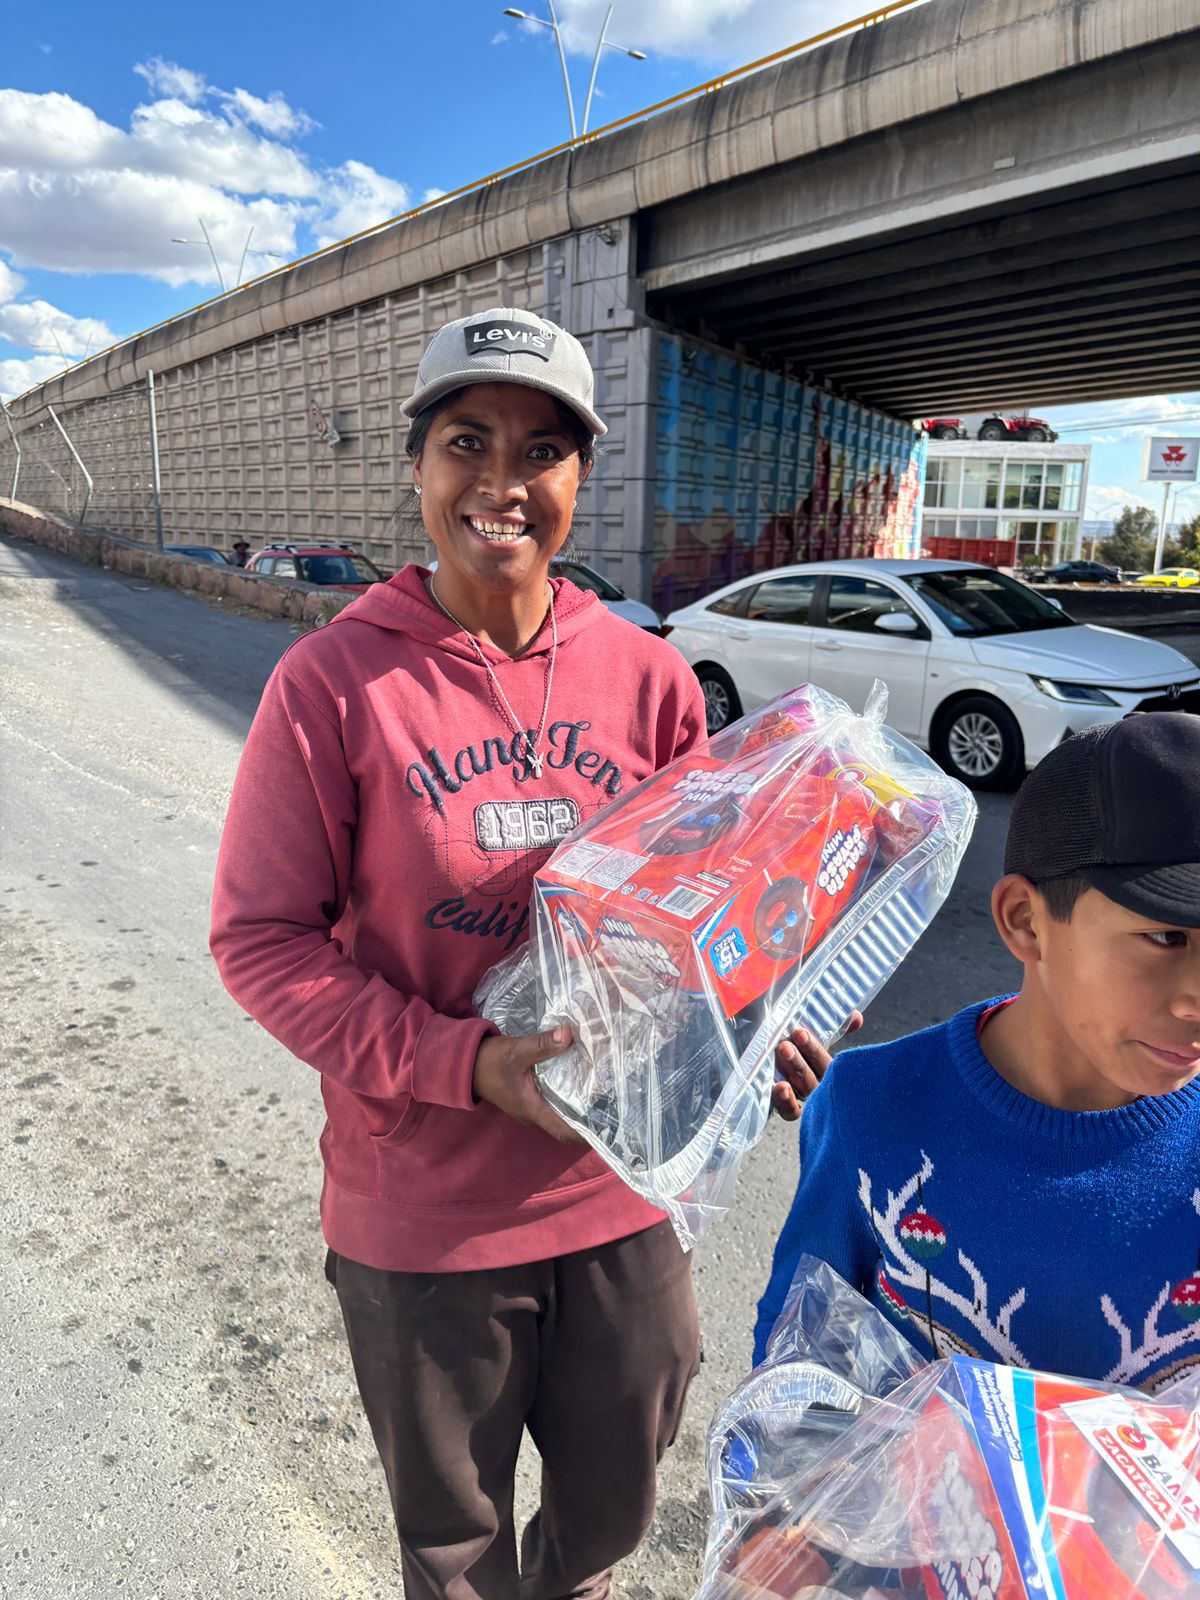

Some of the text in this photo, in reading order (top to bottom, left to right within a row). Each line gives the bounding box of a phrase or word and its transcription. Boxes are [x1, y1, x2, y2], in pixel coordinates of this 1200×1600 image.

[407, 720, 624, 815] Hang Ten
[485, 803, 572, 842] 1962
[818, 823, 861, 888] PAYASO
[821, 829, 844, 864] MINI
[825, 839, 868, 896] PALETA
[425, 896, 530, 951] Calif
[602, 918, 637, 936] MINI
[714, 931, 737, 951] PIEZAS
[720, 940, 742, 969] 15
